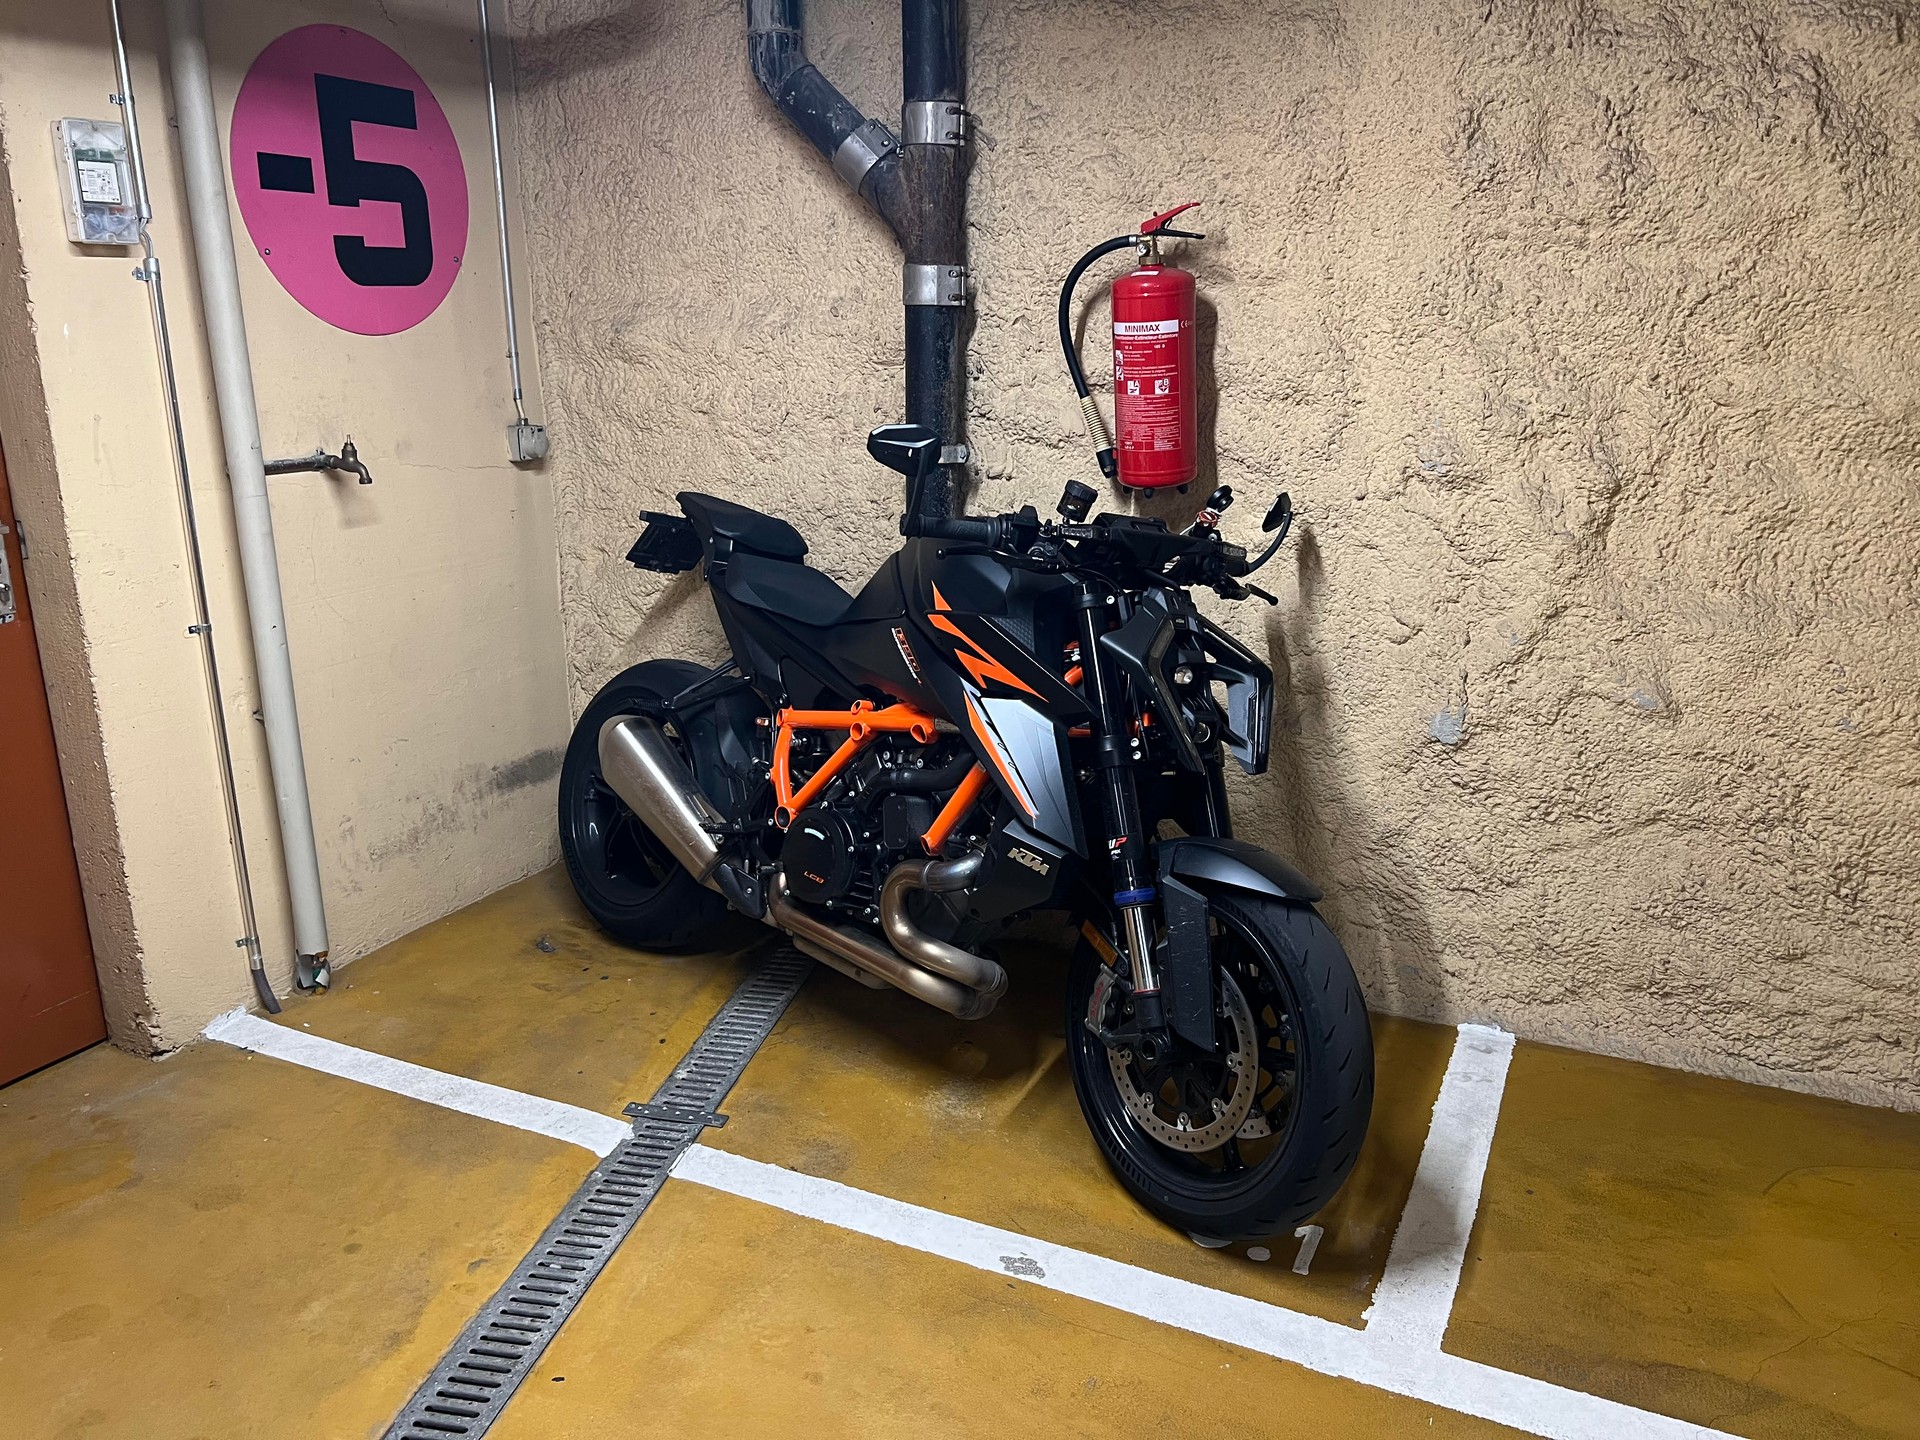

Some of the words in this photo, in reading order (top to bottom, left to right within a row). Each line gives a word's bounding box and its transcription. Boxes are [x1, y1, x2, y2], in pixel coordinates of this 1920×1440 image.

[257, 73, 433, 286] -5
[1124, 324, 1161, 333] MINIMAX
[1007, 847, 1050, 876] KTM
